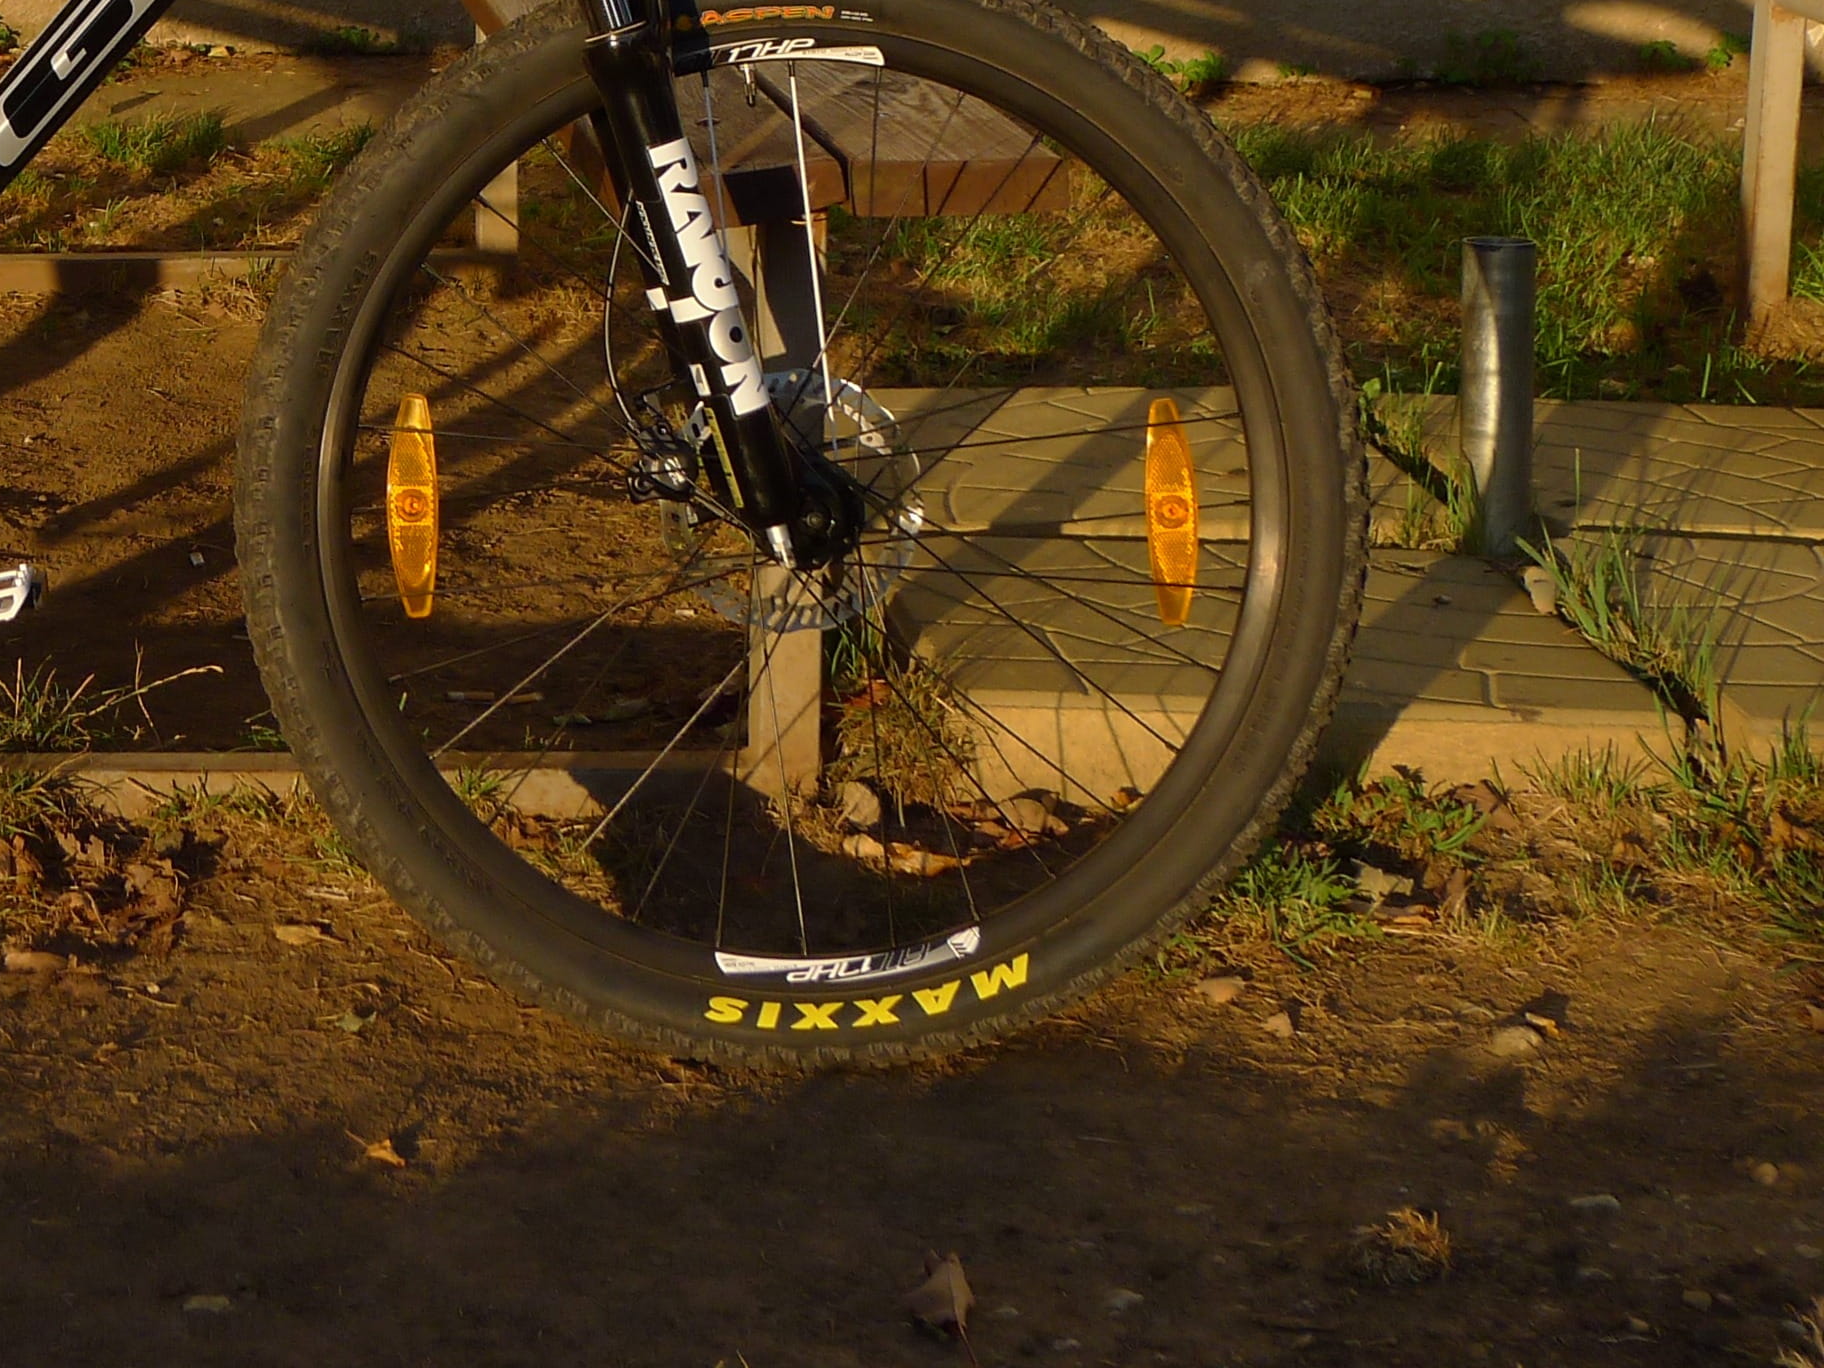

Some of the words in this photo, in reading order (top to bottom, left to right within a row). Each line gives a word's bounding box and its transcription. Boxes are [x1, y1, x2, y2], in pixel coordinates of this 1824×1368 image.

[701, 5, 836, 27] ASPEN
[727, 37, 816, 63] 17HP
[786, 955, 873, 982] 17HP
[704, 952, 1029, 1030] MAXXIS
